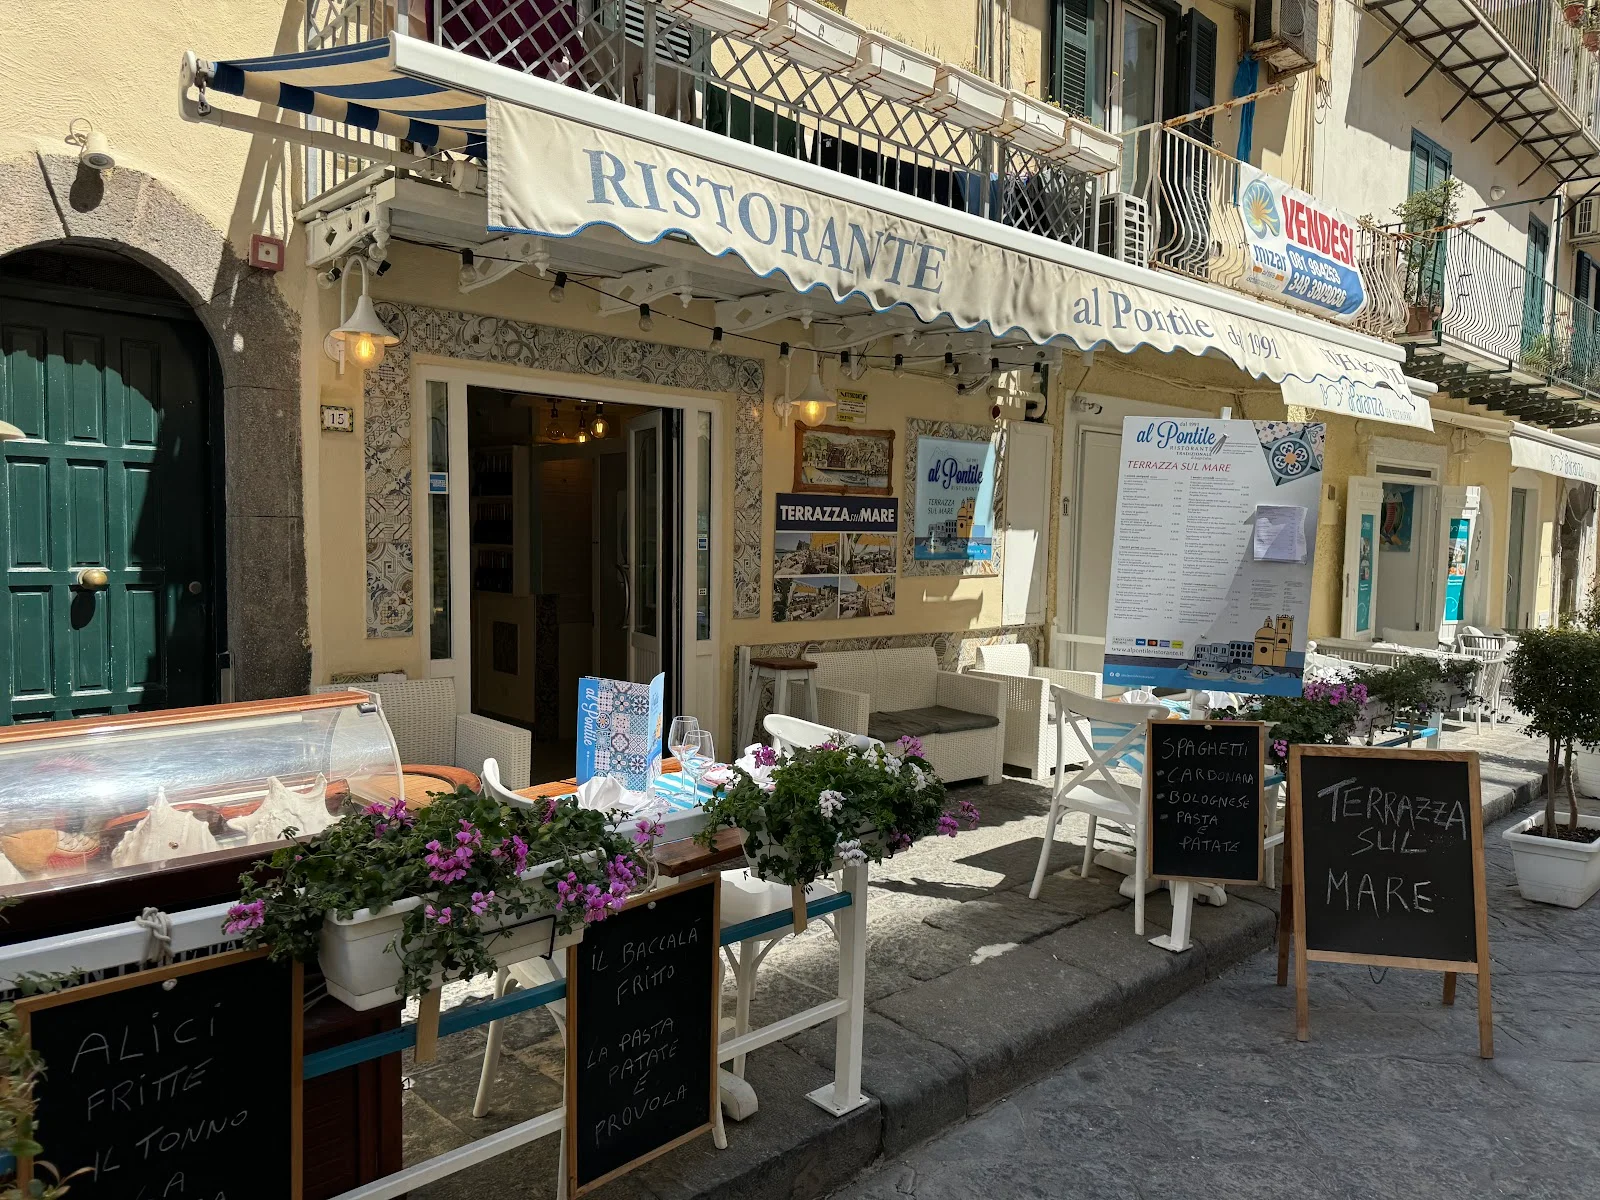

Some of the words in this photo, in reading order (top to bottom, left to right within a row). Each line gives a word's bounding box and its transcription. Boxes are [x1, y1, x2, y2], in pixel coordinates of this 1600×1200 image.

[582, 148, 947, 294] RISTORANTE
[1281, 194, 1356, 267] VENDESI
[1253, 243, 1287, 272] mizar
[1289, 250, 1308, 273] 081
[1307, 258, 1342, 285] 984253
[1289, 272, 1309, 296] 348
[1307, 278, 1347, 308] 3809036
[1073, 288, 1101, 326] al
[1108, 289, 1215, 339] Pontile
[330, 413, 345, 425] 15
[1136, 422, 1155, 443] al
[1157, 421, 1217, 449] Pontile
[928, 459, 942, 482] al
[942, 457, 984, 490] Pontile
[1127, 460, 1178, 471] TERRAZZA
[1180, 462, 1199, 472] SUL
[1201, 463, 1232, 473] MARE
[779, 505, 850, 522] TERRAZZA
[860, 508, 895, 523] MARE
[928, 498, 955, 507] TERRAZZA
[928, 507, 938, 515] SUL
[585, 687, 598, 701] al
[581, 702, 599, 746] Pontile
[1168, 790, 1250, 809] BOLOGNESE
[1317, 776, 1467, 841] TERRAZZA
[1176, 811, 1218, 826] PASTA
[1197, 825, 1209, 836] E
[1179, 836, 1241, 853] PATATE
[1351, 826, 1427, 856] SUL
[1326, 868, 1436, 919] MARE
[587, 1046, 608, 1069] LA
[619, 1017, 674, 1052] PASTA
[609, 1039, 679, 1085] PATATE
[595, 1084, 688, 1146] PROVOLA
[94, 1146, 120, 1182] IL
[136, 1110, 248, 1160] TONNO
